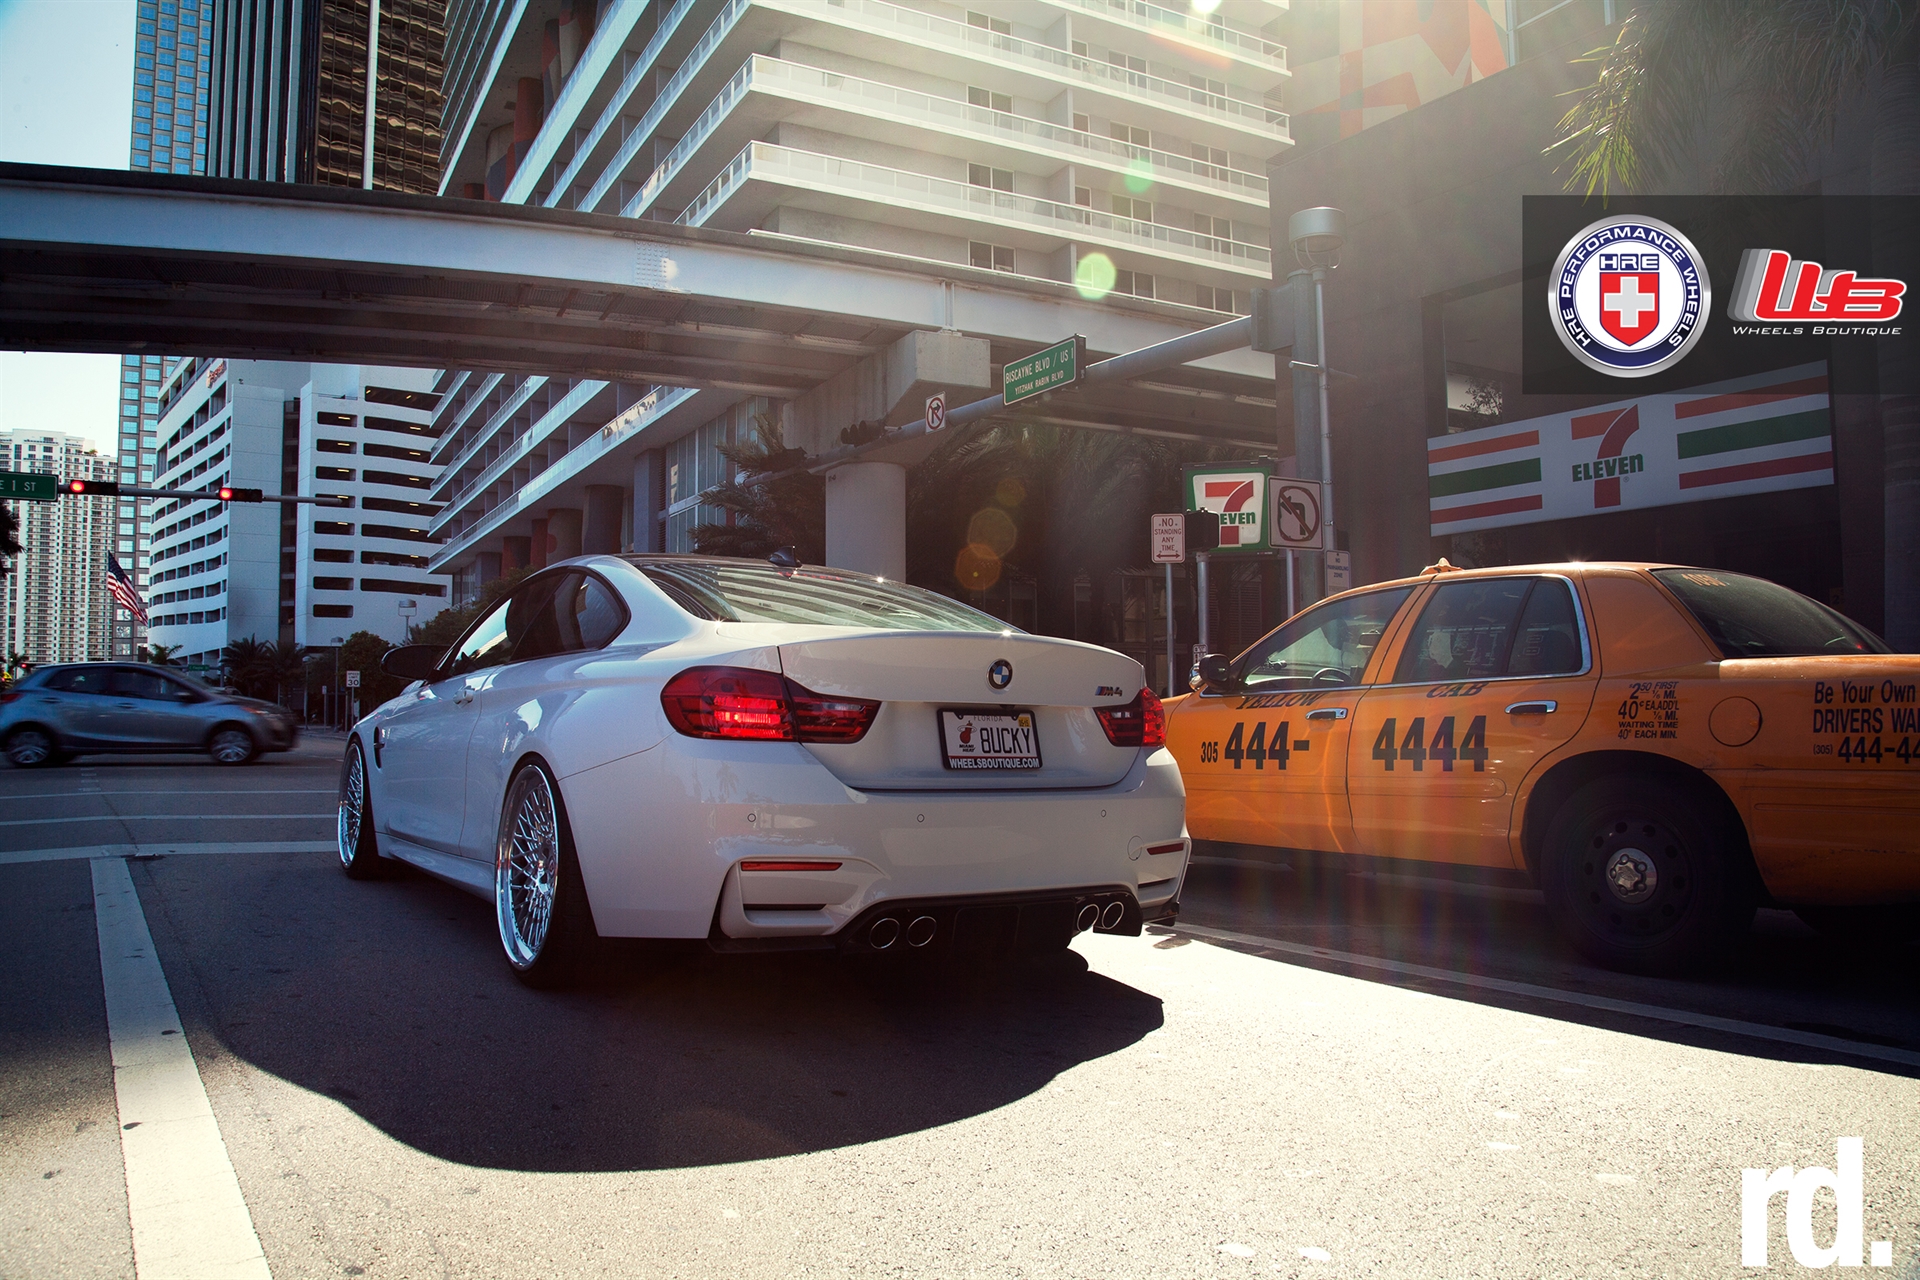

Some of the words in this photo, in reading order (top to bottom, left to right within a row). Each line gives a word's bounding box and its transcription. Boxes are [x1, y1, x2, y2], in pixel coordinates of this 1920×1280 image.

[1005, 364, 1033, 384] BISCAYNE
[1035, 356, 1050, 373] BLVD
[1060, 348, 1069, 363] US
[1014, 382, 1033, 395] YITZHAK
[1035, 375, 1050, 388] RABIN
[1051, 370, 1064, 382] BLVD
[1570, 403, 1640, 509] 7
[24, 482, 36, 491] ST
[1161, 517, 1174, 527] NO
[1204, 480, 1254, 546] 7
[1426, 681, 1489, 698] CAB
[1654, 681, 1679, 690] FIRST
[1814, 681, 1834, 704] Be
[1841, 680, 1875, 703] Your
[1881, 679, 1916, 703] Own
[1236, 692, 1326, 710] YELLOW
[1813, 708, 1884, 734] DRIVERS
[1891, 708, 1920, 733] WA
[1200, 741, 1218, 763] 305
[1372, 715, 1489, 772] 4444
[1634, 730, 1657, 739] EACH
[1660, 730, 1678, 739] MIN.
[1813, 744, 1833, 755] (305)
[949, 758, 1040, 769] WHEELSBOUTIQUE.COM
